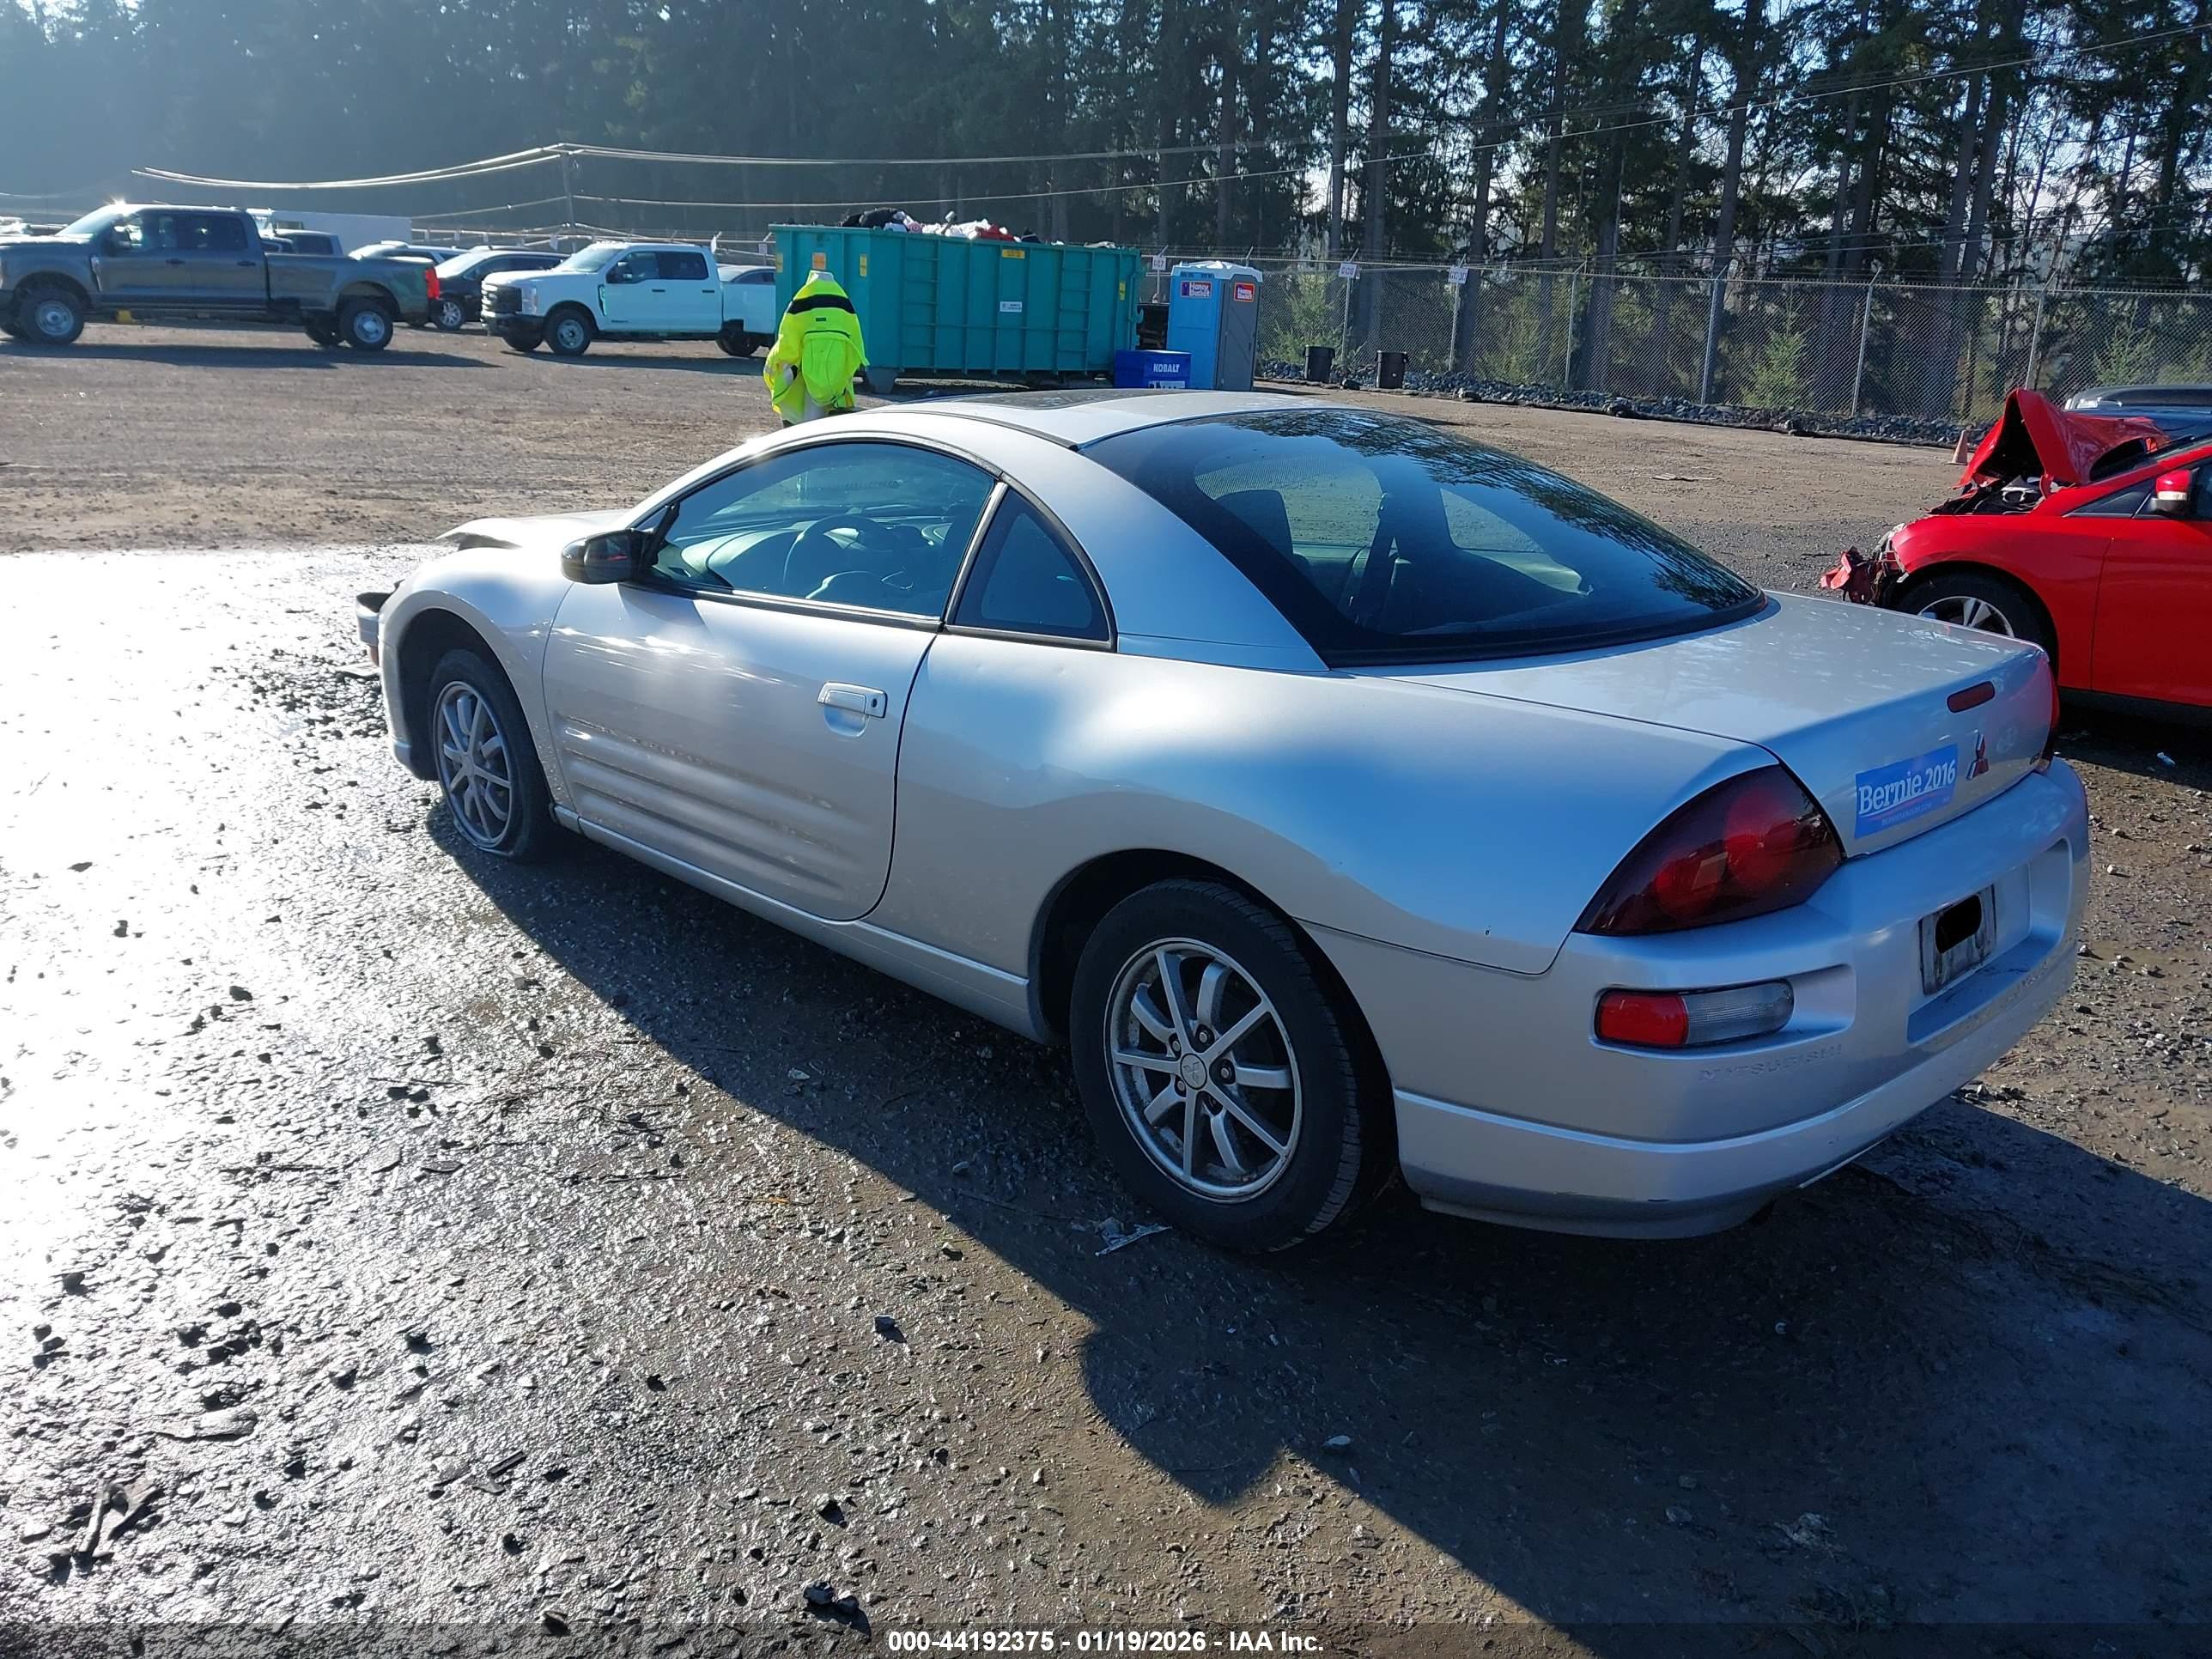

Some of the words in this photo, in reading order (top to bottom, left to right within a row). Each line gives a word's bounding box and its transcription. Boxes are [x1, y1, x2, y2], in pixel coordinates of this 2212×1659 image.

[1153, 363, 1180, 373] KOBALT
[1858, 771, 1922, 815] Bernie
[1924, 759, 1955, 792] 2016
